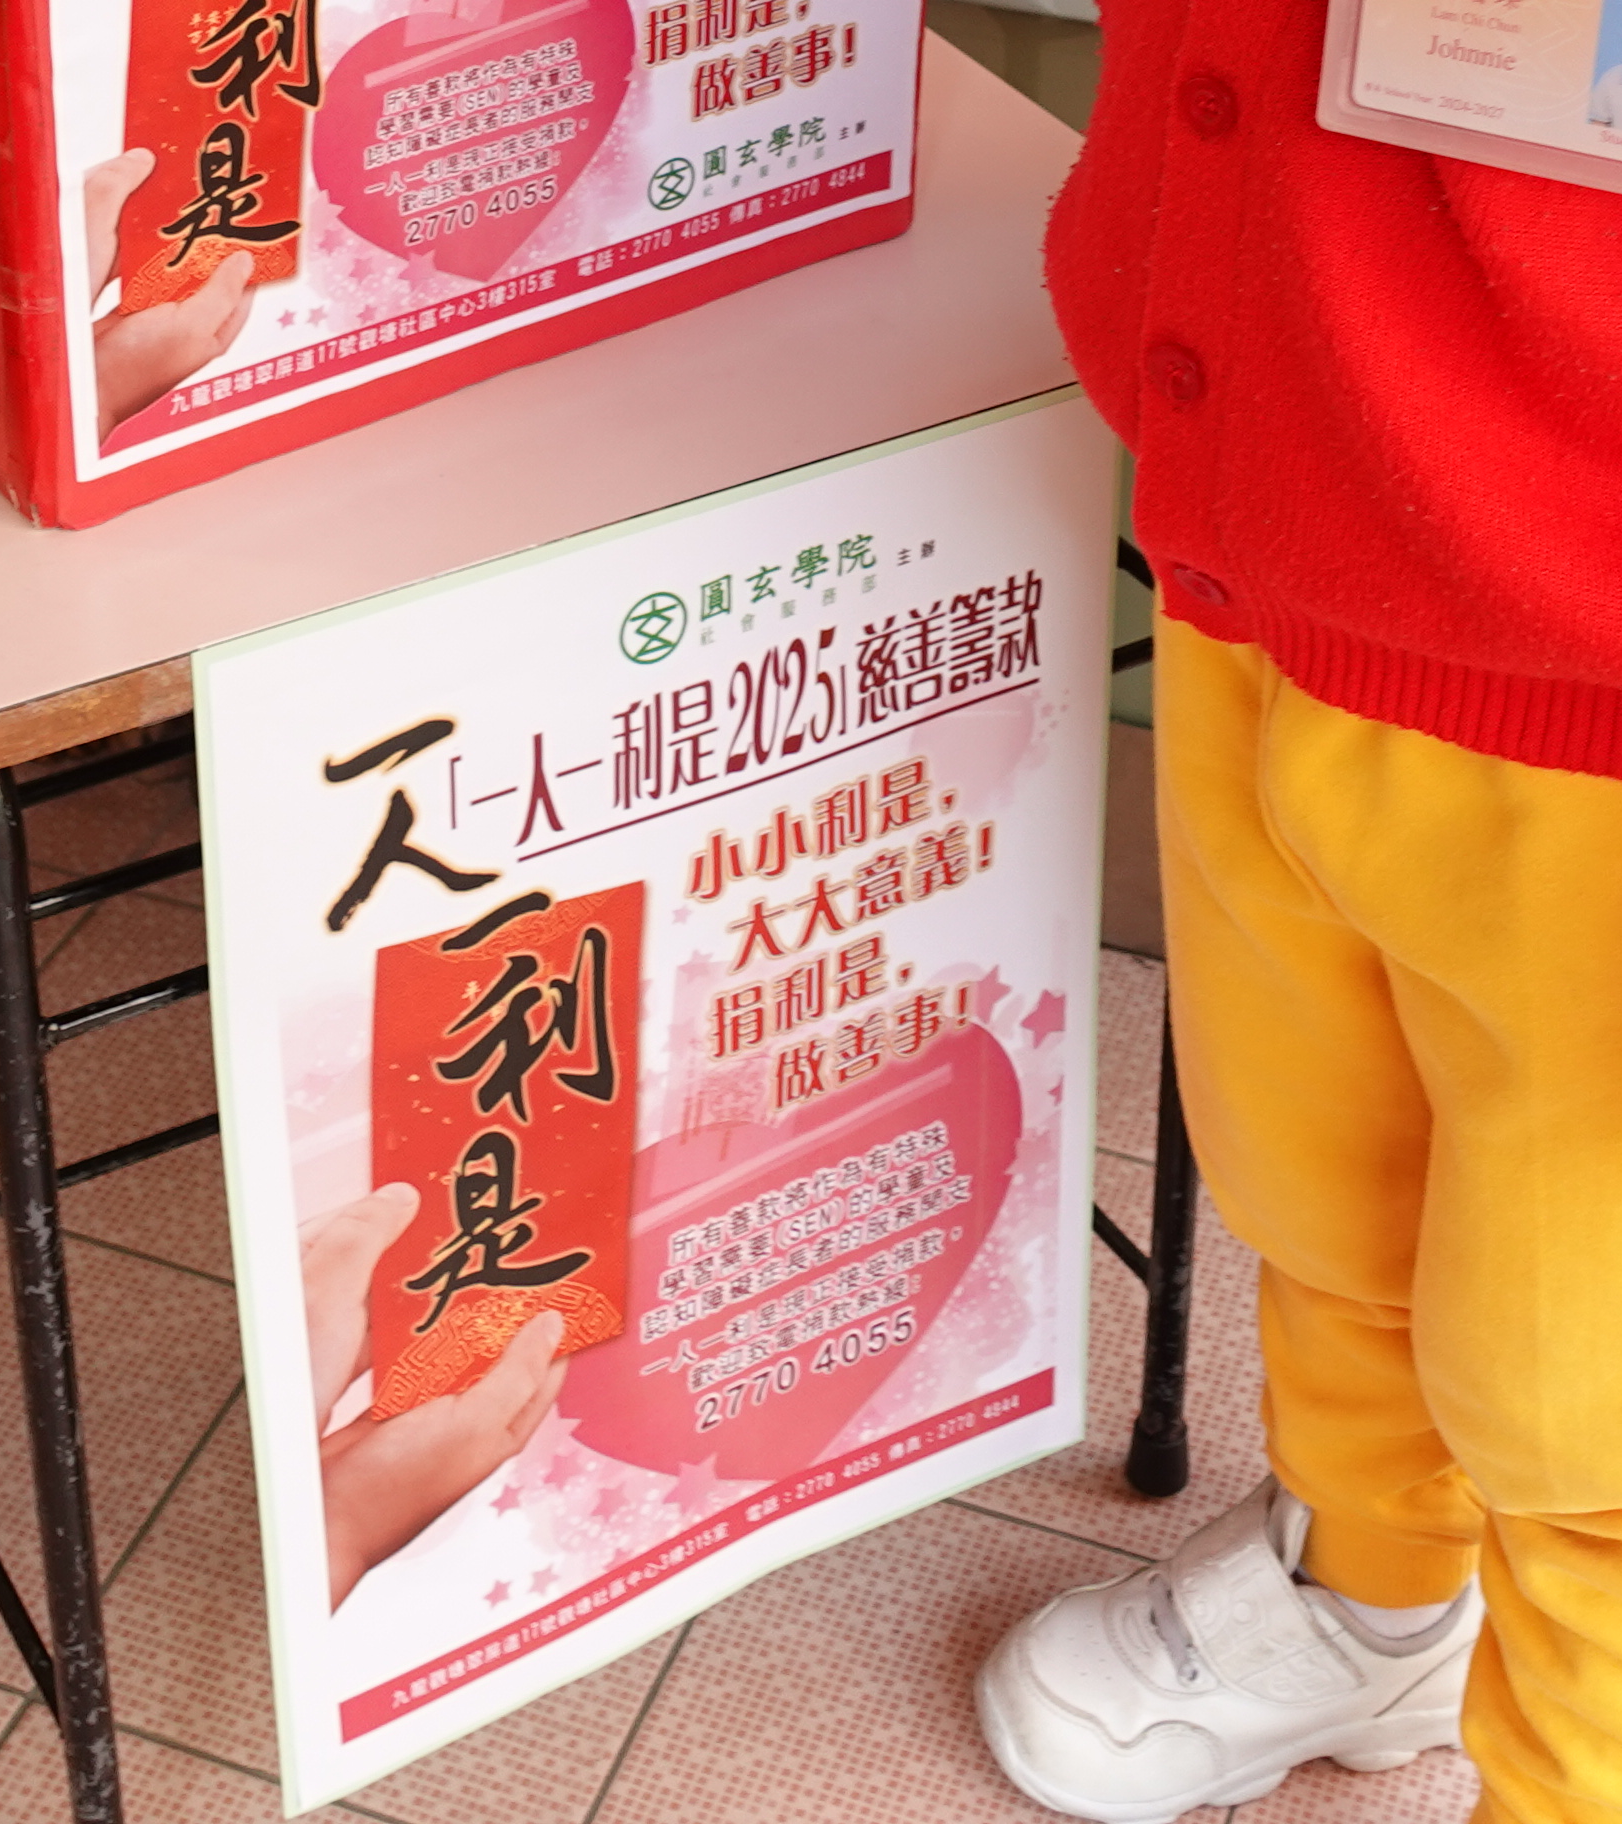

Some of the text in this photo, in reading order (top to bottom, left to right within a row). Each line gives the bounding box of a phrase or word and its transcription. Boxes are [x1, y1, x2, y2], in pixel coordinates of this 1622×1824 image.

[1426, 34, 1518, 71] Johnnie
[703, 117, 827, 179] 圓玄學院
[406, 177, 556, 244] 2770 4055
[681, 211, 721, 239] 4055
[699, 533, 936, 622] 圓玄學院 主辦
[698, 1309, 915, 1431] 2770 4055
